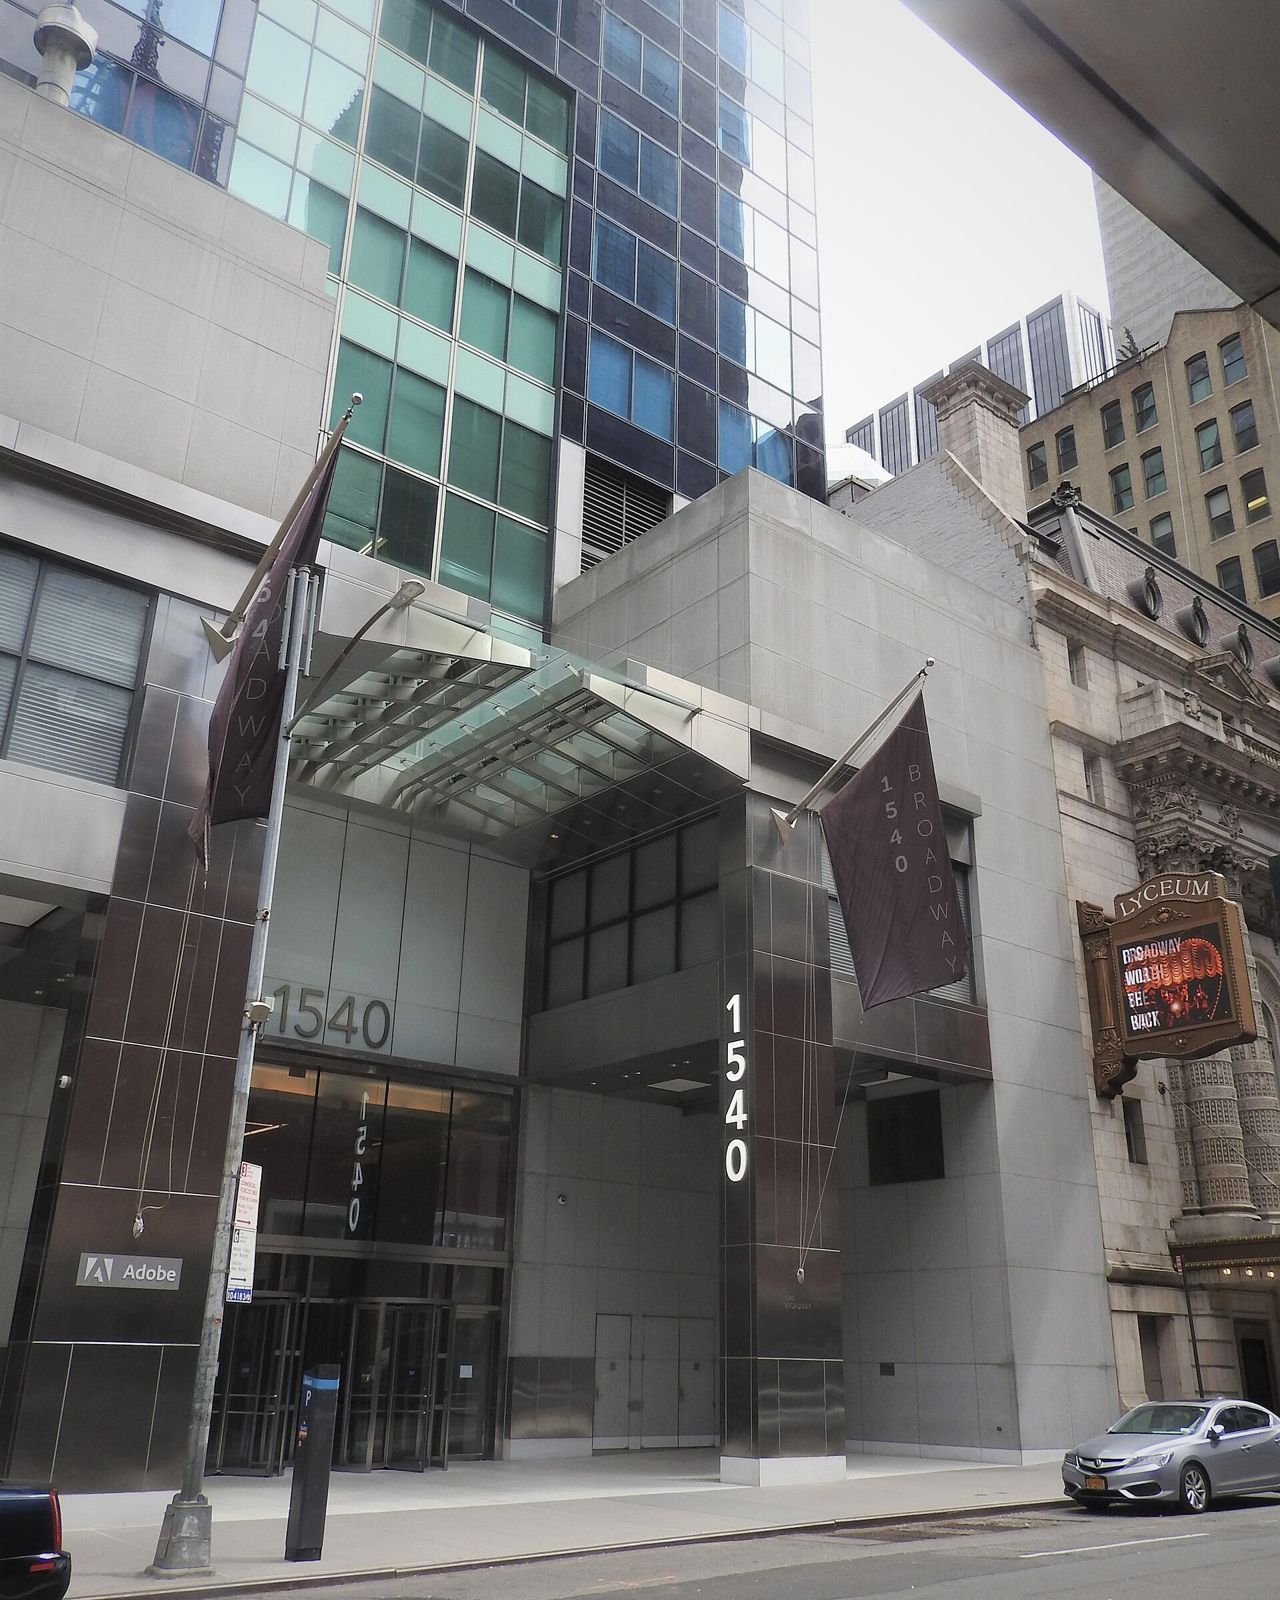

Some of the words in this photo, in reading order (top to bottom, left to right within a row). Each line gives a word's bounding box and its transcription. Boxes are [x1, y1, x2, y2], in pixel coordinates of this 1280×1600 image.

[880, 775, 908, 873] 1540
[908, 764, 960, 974] BROADWAY
[1118, 878, 1210, 918] LYCEUM
[1122, 937, 1181, 965] BROADWAY
[273, 984, 391, 1049] 1540
[725, 993, 748, 1182] 1540
[122, 1263, 176, 1282] Adobe
